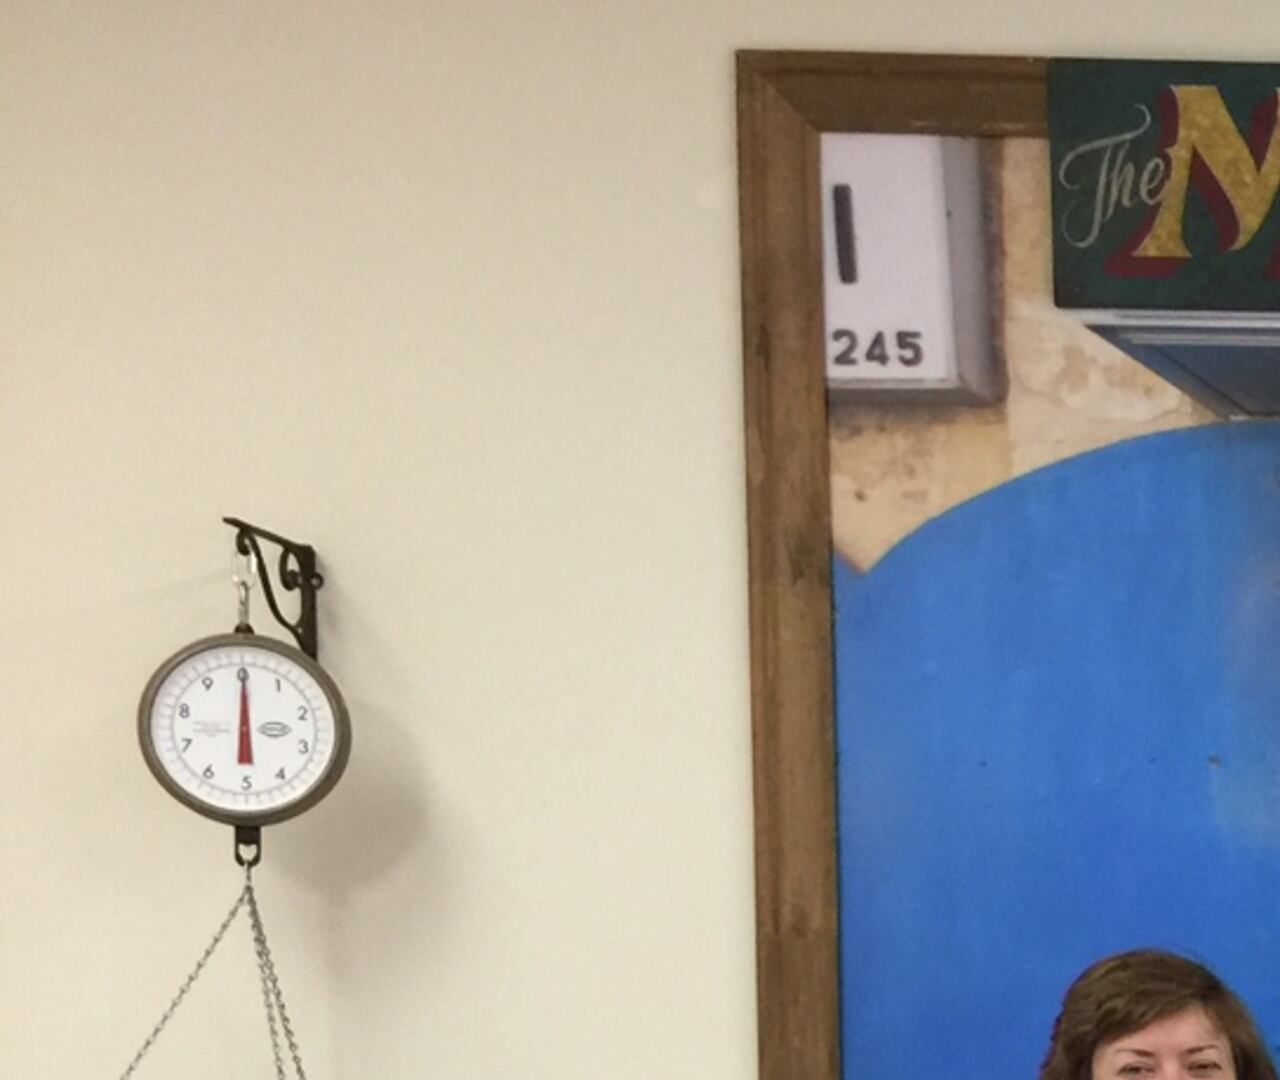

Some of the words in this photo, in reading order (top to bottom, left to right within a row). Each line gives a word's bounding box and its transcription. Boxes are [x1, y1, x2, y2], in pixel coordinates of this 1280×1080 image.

[1058, 103, 1167, 249] The
[832, 329, 924, 367] 245
[202, 677, 214, 691] 9
[179, 704, 190, 718] 8
[298, 706, 308, 720] 2
[181, 738, 193, 753] 7
[299, 740, 309, 754] 3
[202, 765, 214, 779] 6
[275, 768, 285, 781] 4
[242, 776, 252, 791] 5
